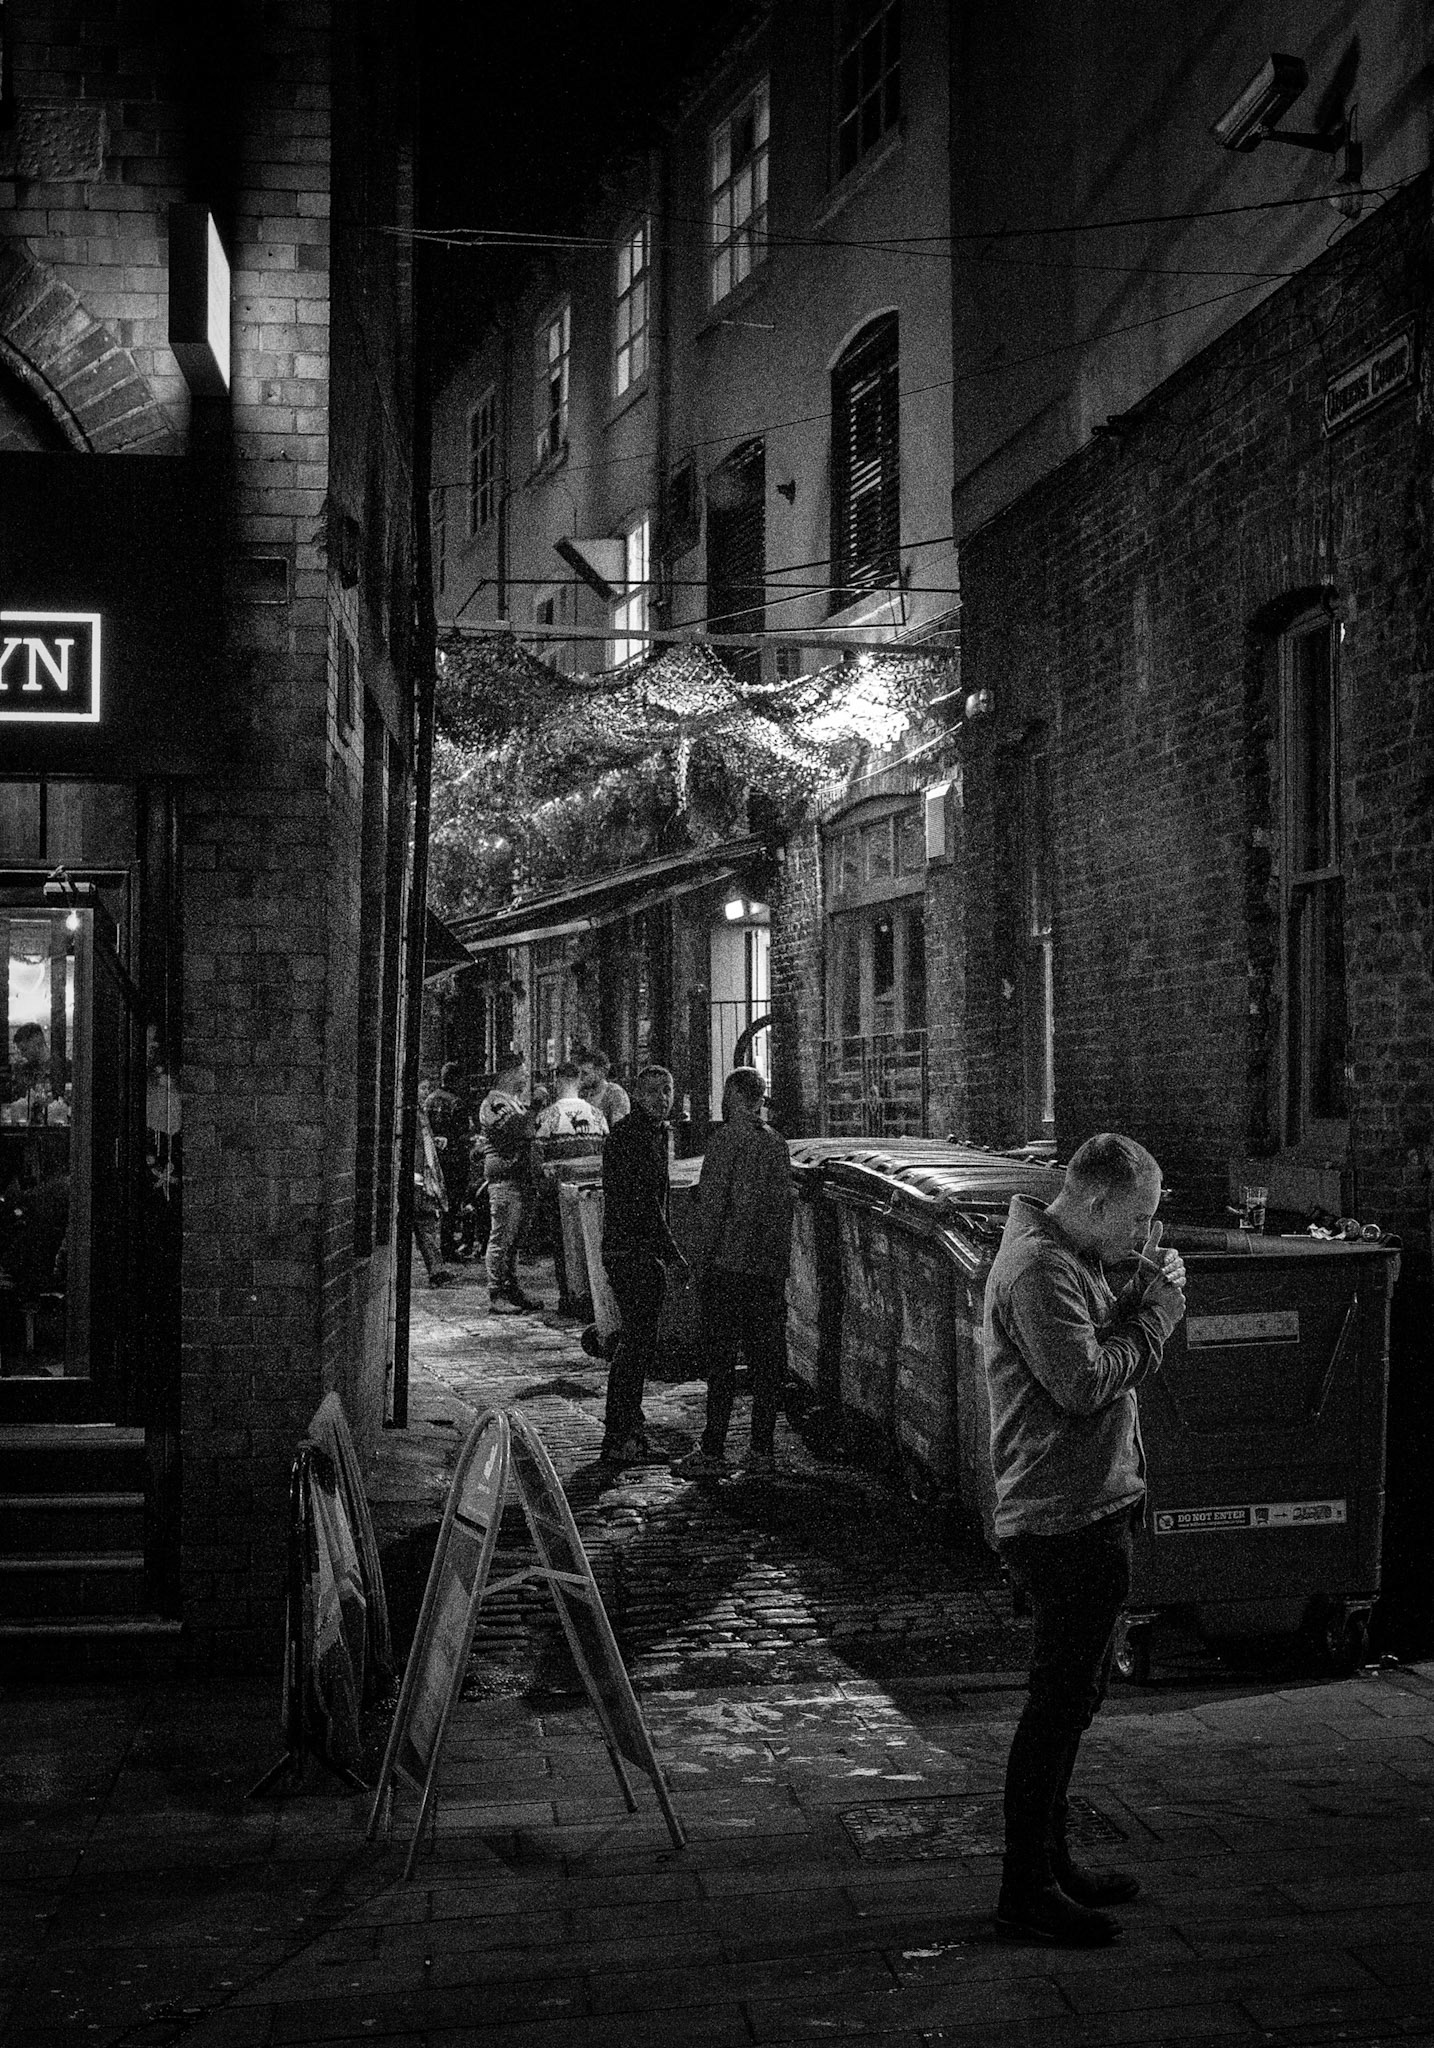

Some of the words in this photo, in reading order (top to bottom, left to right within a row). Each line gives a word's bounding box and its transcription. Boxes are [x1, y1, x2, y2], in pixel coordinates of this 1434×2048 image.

[1178, 1514, 1191, 1523] DO
[1192, 1513, 1212, 1521] NOT
[1213, 1510, 1245, 1520] ENTER
